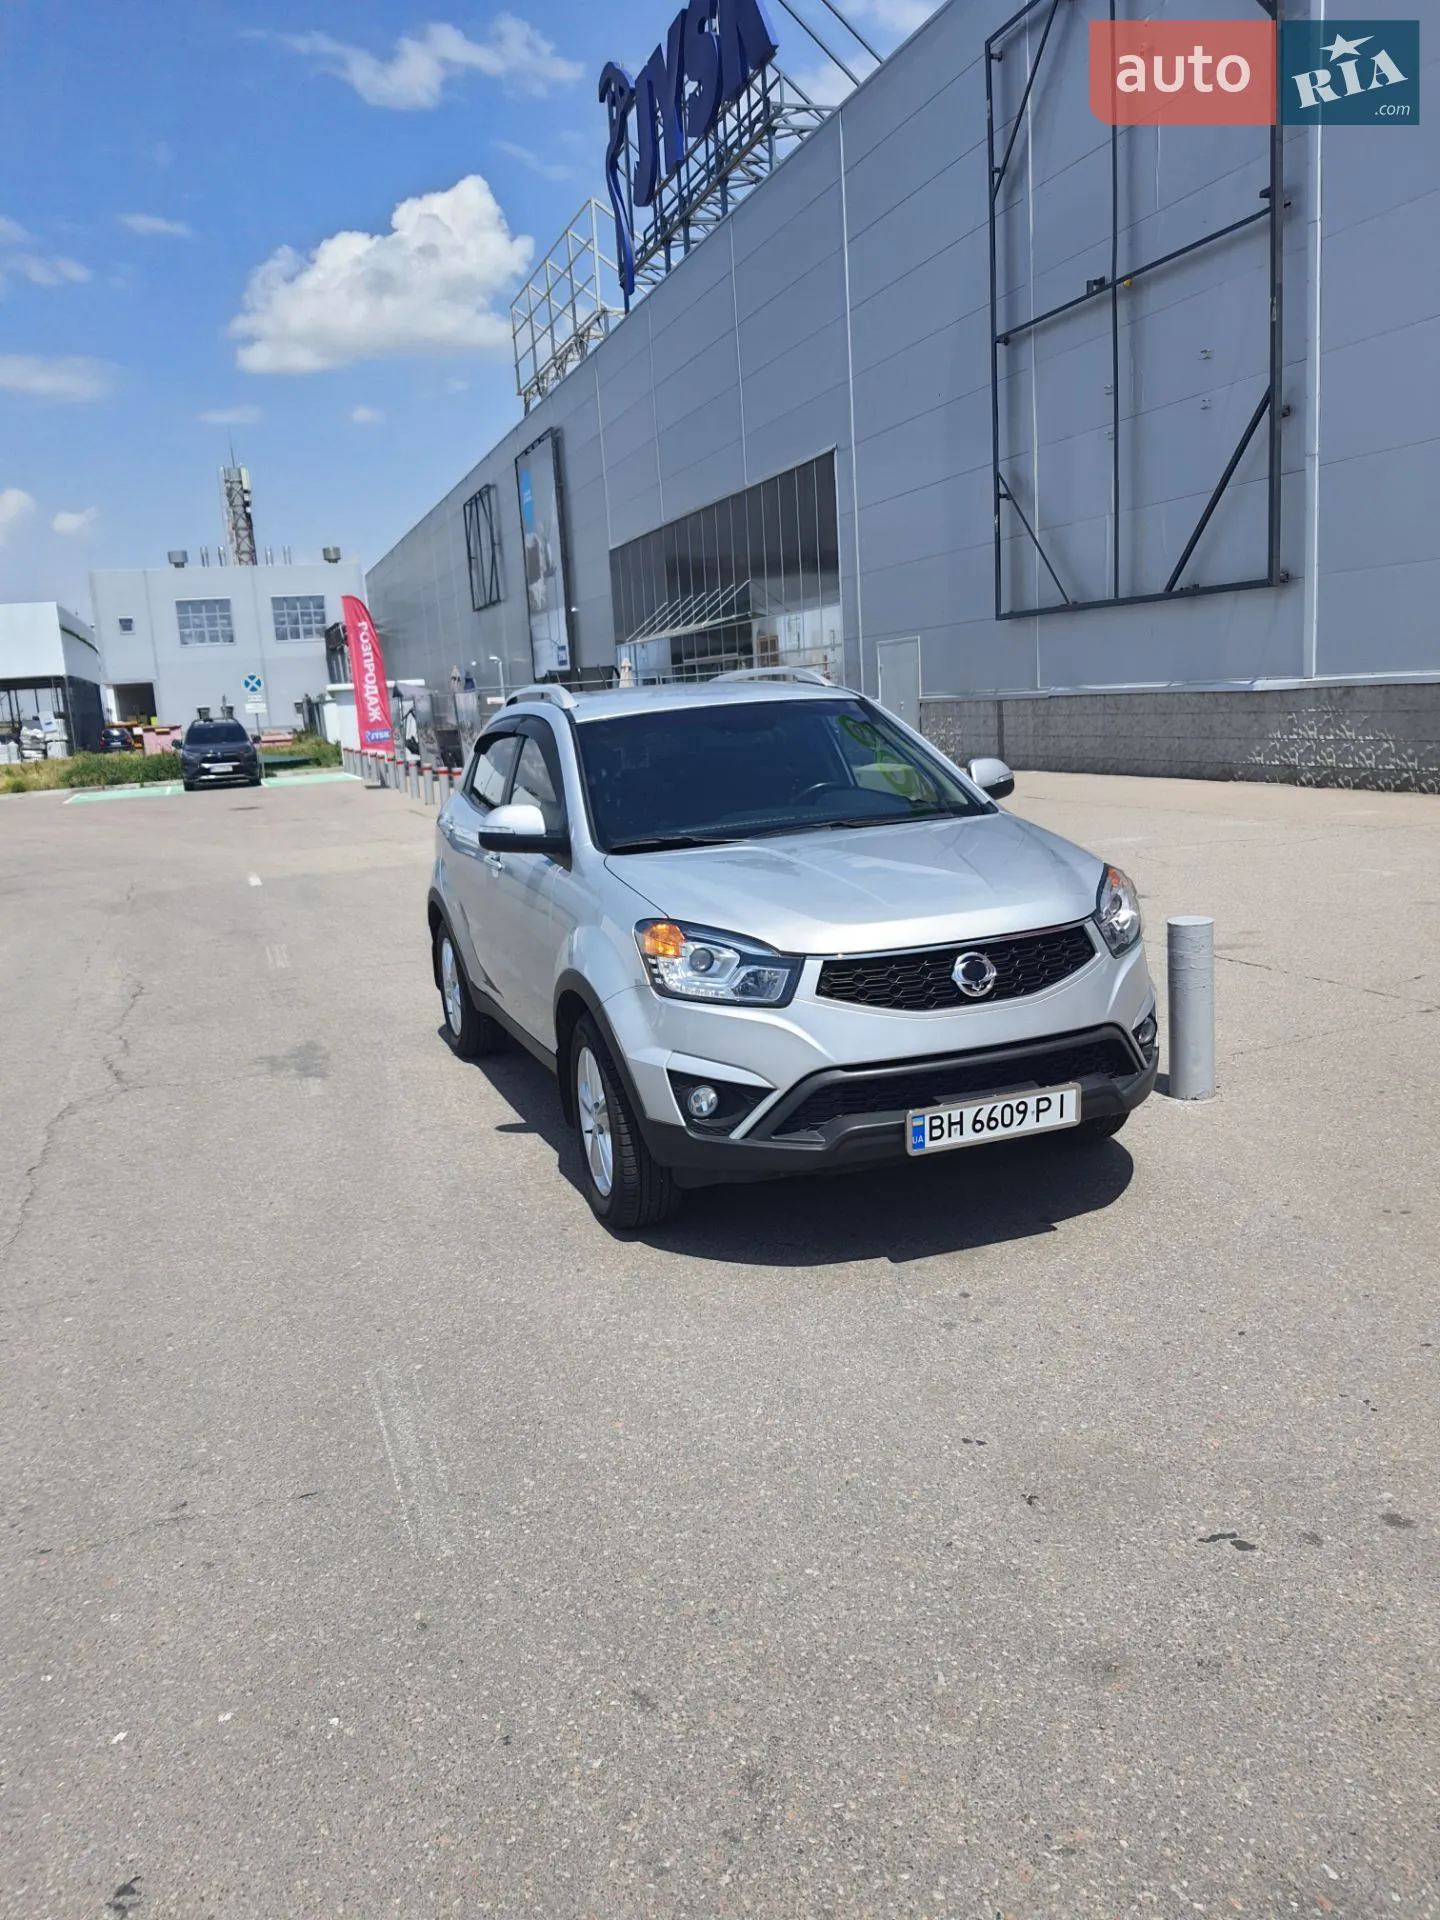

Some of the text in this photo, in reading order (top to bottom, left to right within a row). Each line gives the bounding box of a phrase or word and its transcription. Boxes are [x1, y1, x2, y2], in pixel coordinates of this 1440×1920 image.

[358, 621, 381, 722] РОЗПРОДАЖ
[912, 1136, 924, 1144] UA
[929, 1094, 1064, 1141] BH 6609 PI
